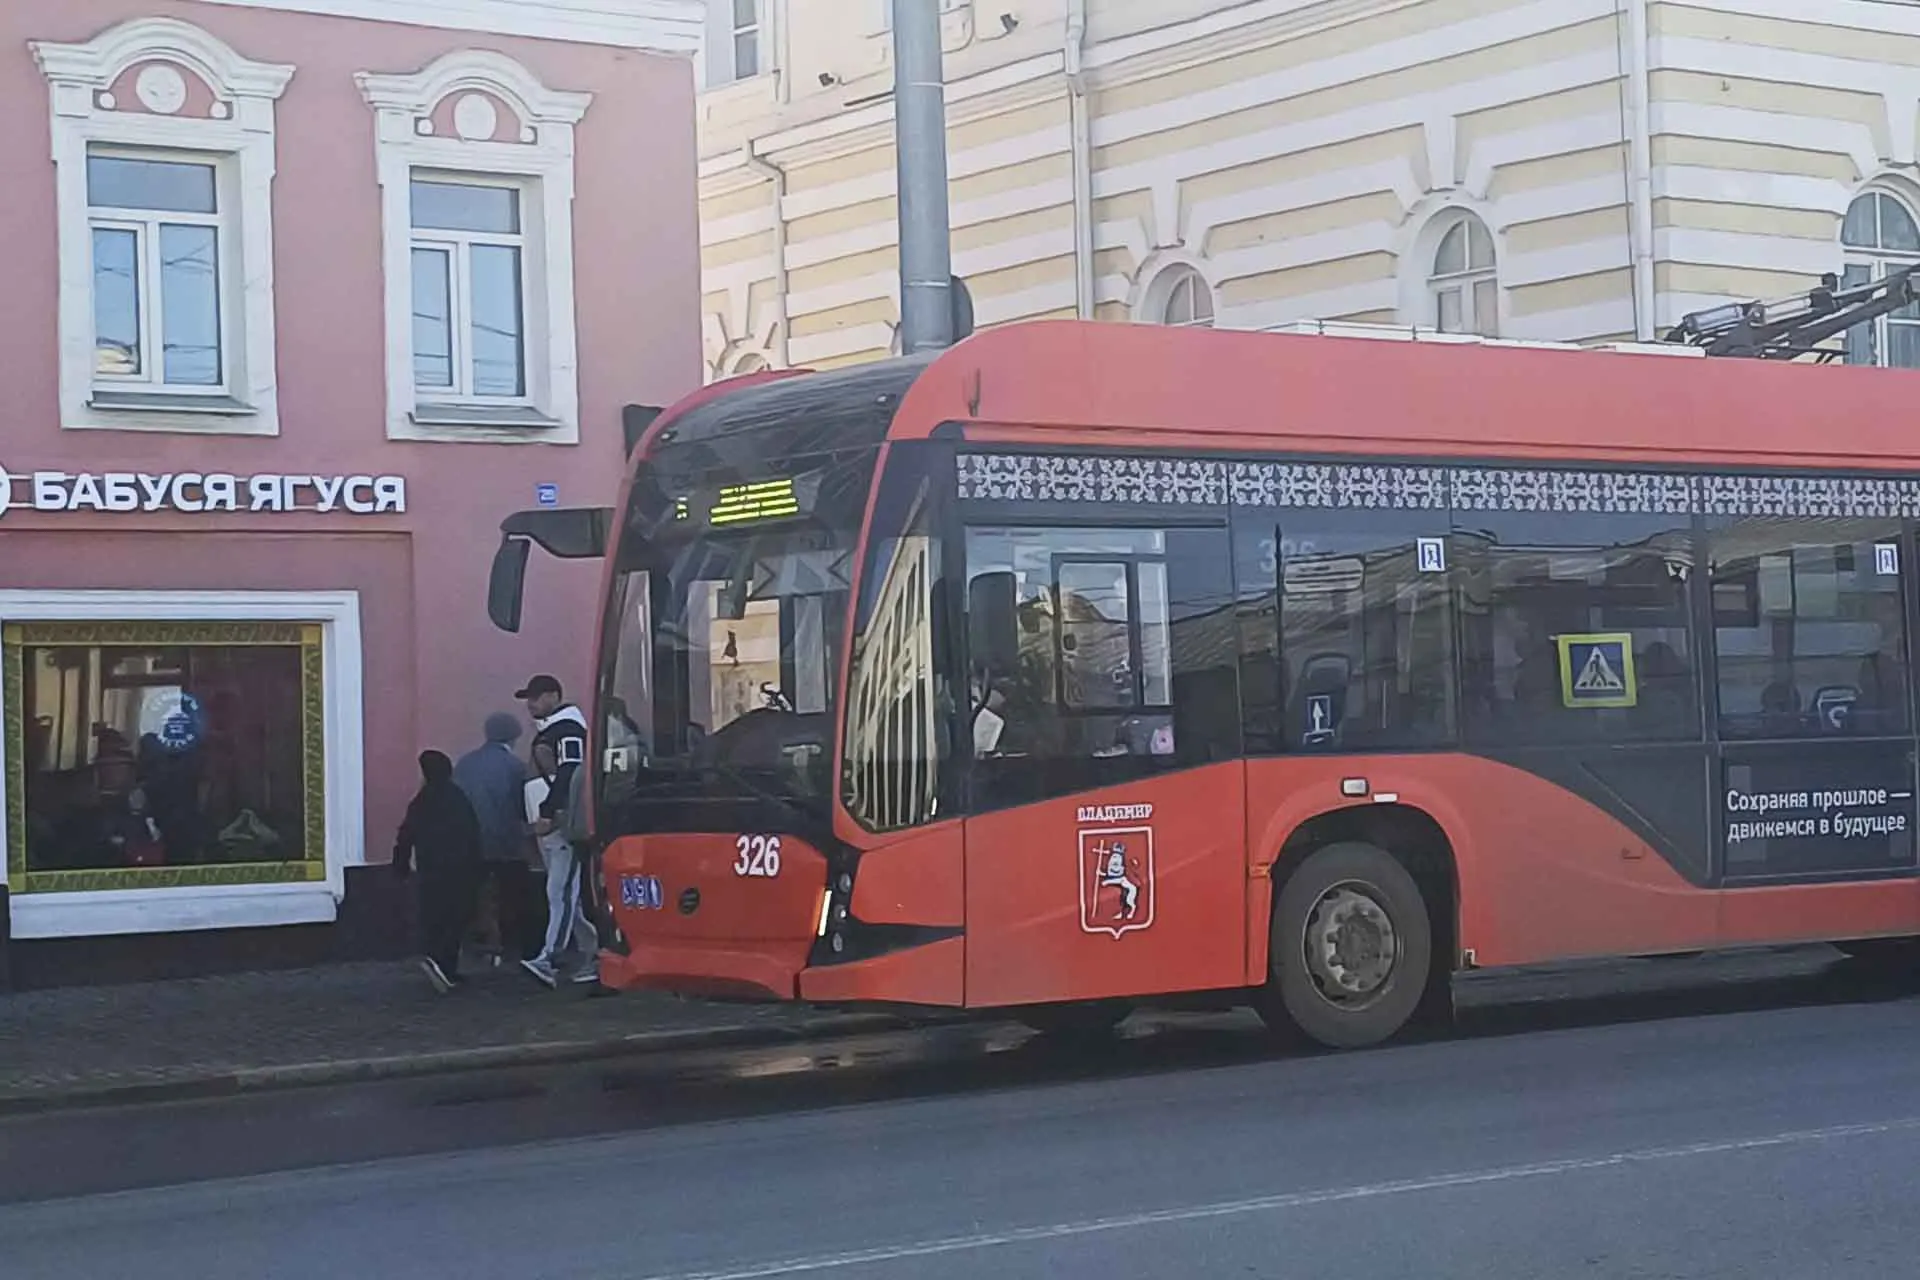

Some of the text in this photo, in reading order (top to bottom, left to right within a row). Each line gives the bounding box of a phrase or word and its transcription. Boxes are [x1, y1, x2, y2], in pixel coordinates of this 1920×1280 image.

[33, 471, 406, 514] БАБУСЯ ЯГУСЯ
[1727, 790, 1808, 815] Сохраняя
[1812, 788, 1887, 812] прошлое
[1728, 812, 1906, 843] движемся в будущее
[733, 834, 781, 877] 326
